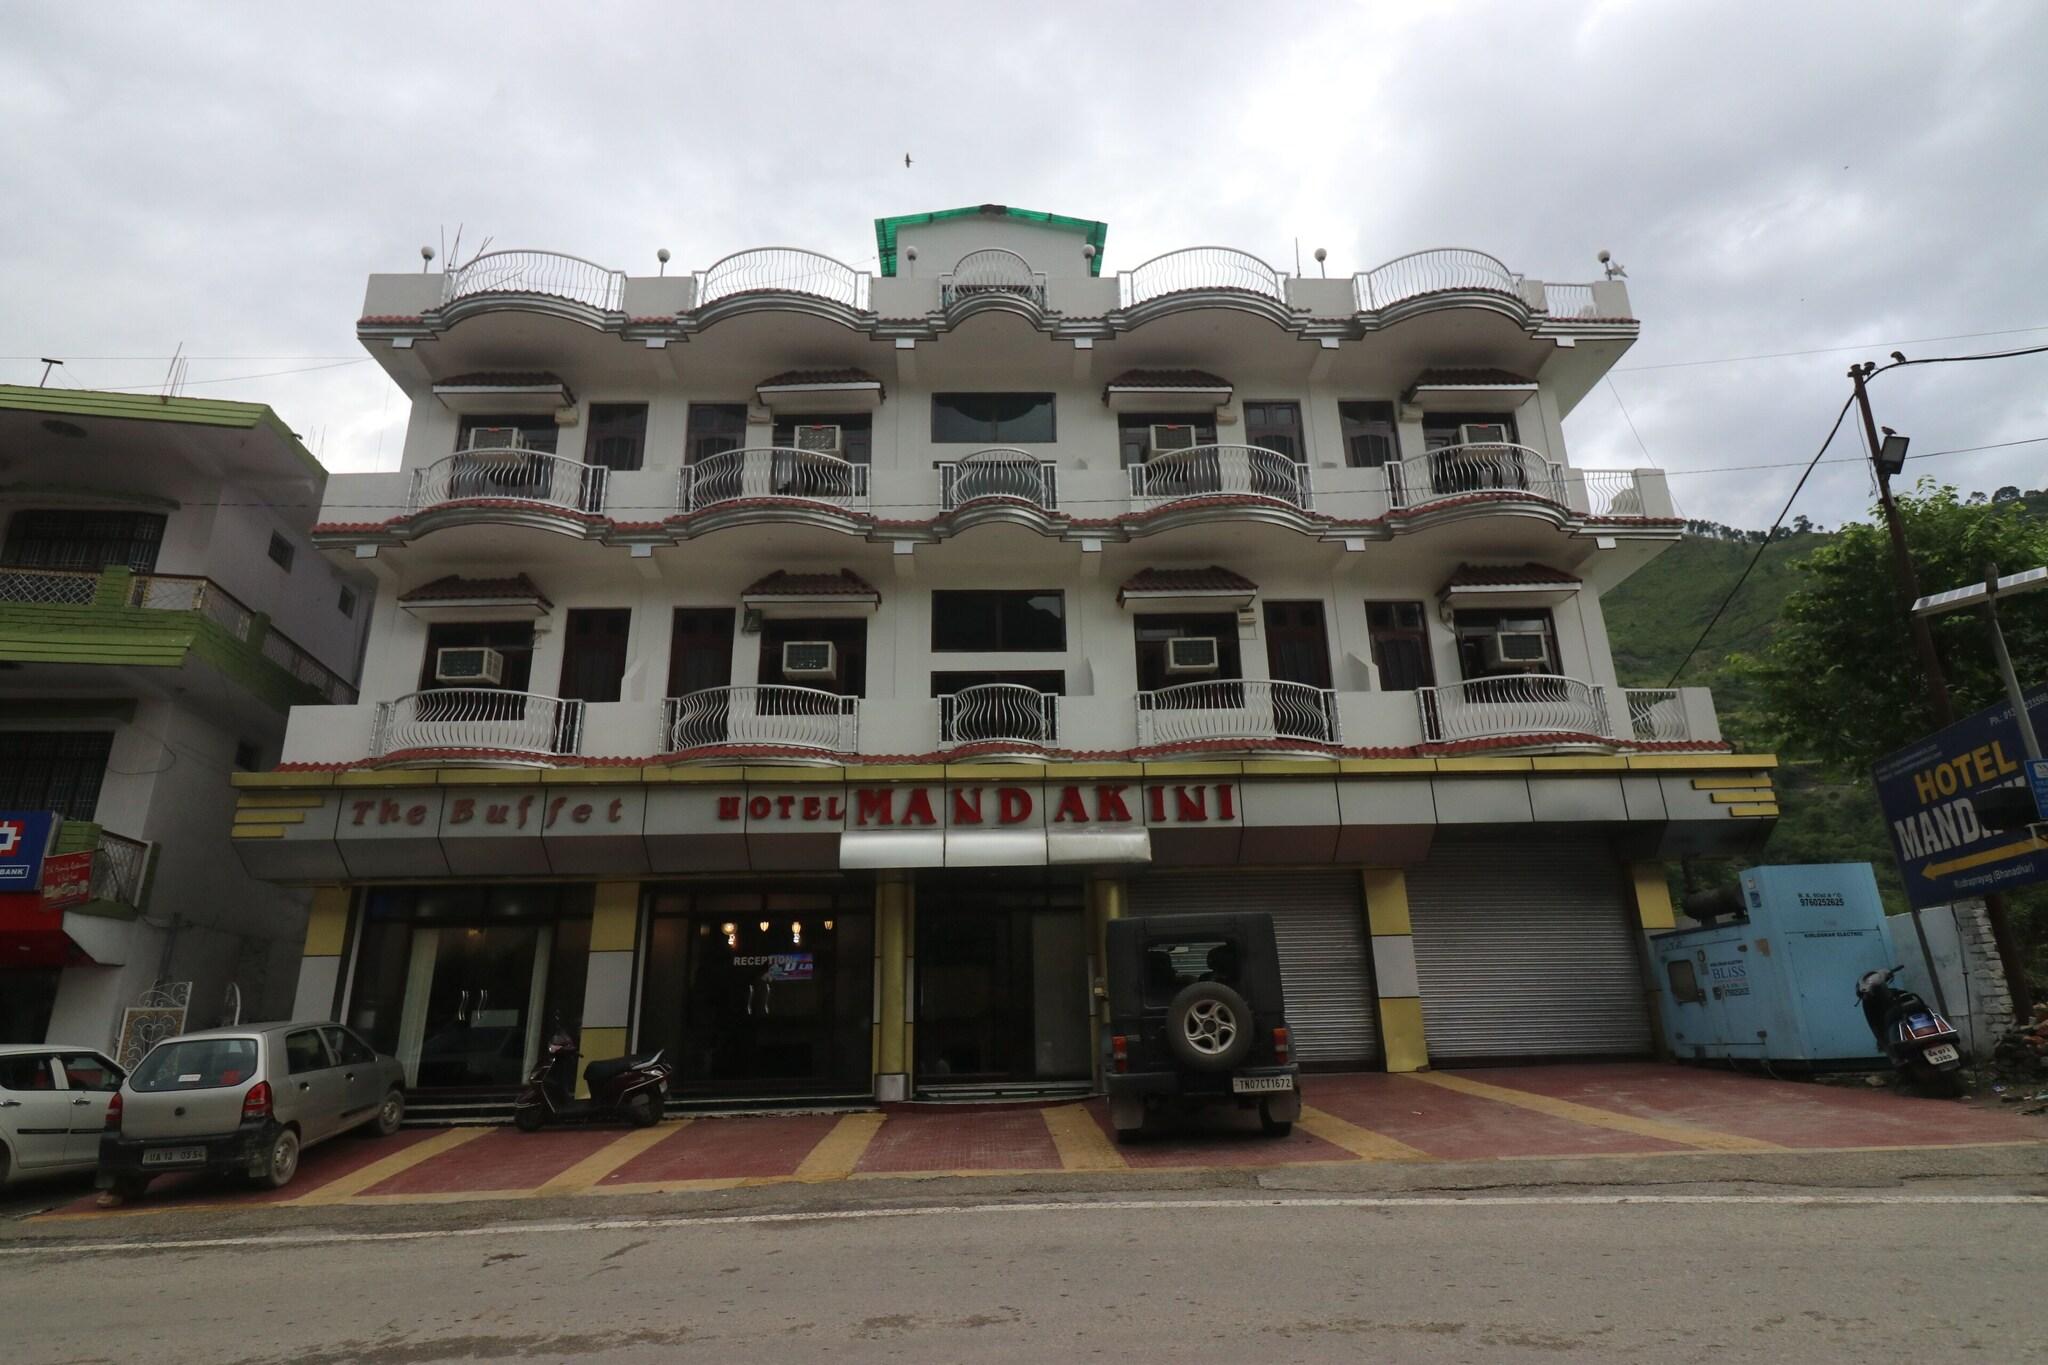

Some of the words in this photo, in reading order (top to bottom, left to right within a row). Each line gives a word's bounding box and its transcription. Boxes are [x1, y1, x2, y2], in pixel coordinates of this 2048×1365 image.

[1913, 740, 2018, 805] HOTEL
[352, 797, 427, 826] The
[449, 795, 623, 831] Buffet
[717, 795, 845, 821] HOTEL
[857, 784, 1236, 825] MANDAKINI
[733, 955, 792, 967] RECEPTION
[1240, 1078, 1291, 1090] TN07CT1672
